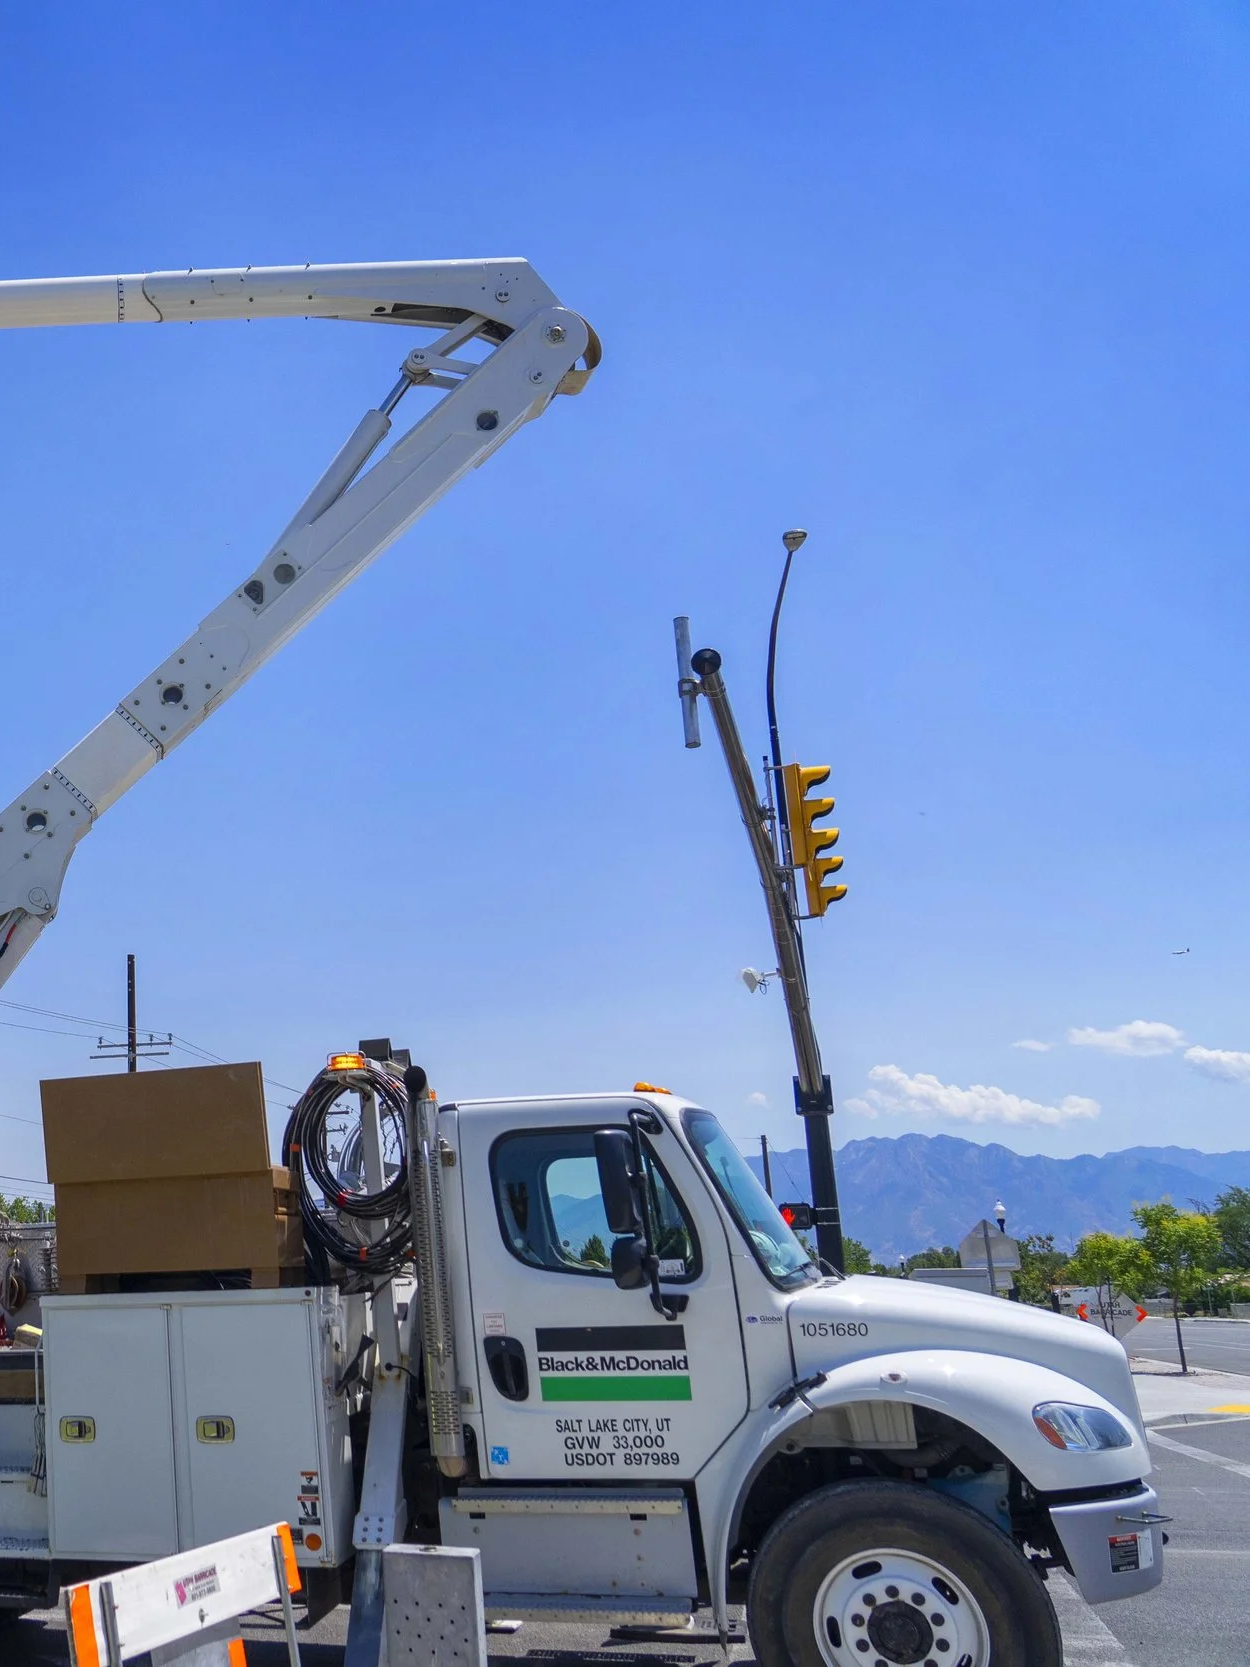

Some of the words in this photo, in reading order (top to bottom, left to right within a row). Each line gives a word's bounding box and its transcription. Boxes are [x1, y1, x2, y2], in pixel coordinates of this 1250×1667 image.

[800, 1323, 868, 1336] 1051680
[538, 1355, 689, 1371] Black&McDonald
[555, 1419, 583, 1433] SALT
[588, 1418, 618, 1433] LAKE
[623, 1418, 652, 1434] CITY,
[656, 1418, 671, 1432] UT
[564, 1436, 600, 1450] GVW
[612, 1435, 665, 1451] 33,000
[564, 1453, 616, 1467] USDOT
[624, 1452, 680, 1466] 897989
